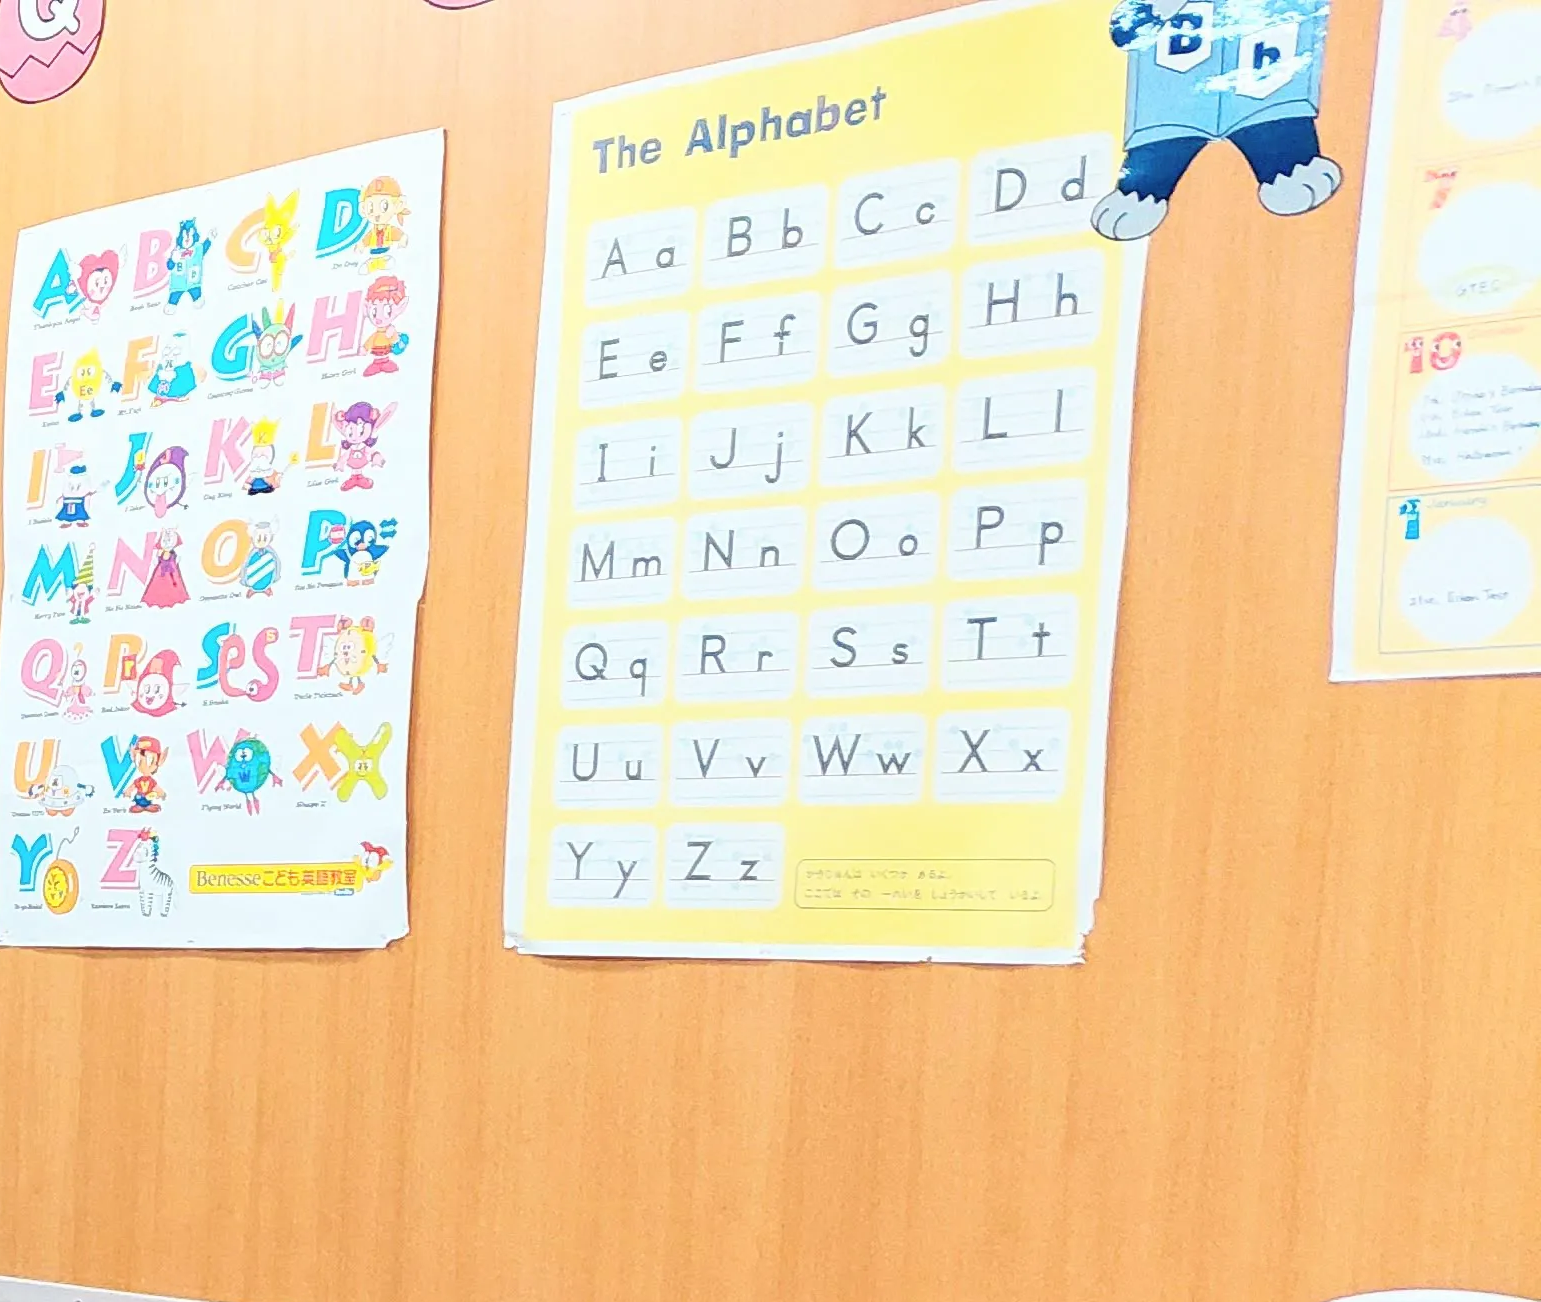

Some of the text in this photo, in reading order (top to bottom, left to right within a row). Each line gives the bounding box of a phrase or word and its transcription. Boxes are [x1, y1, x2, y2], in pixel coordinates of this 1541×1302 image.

[593, 87, 887, 174] The Alphabet
[197, 870, 261, 887] Benesse
